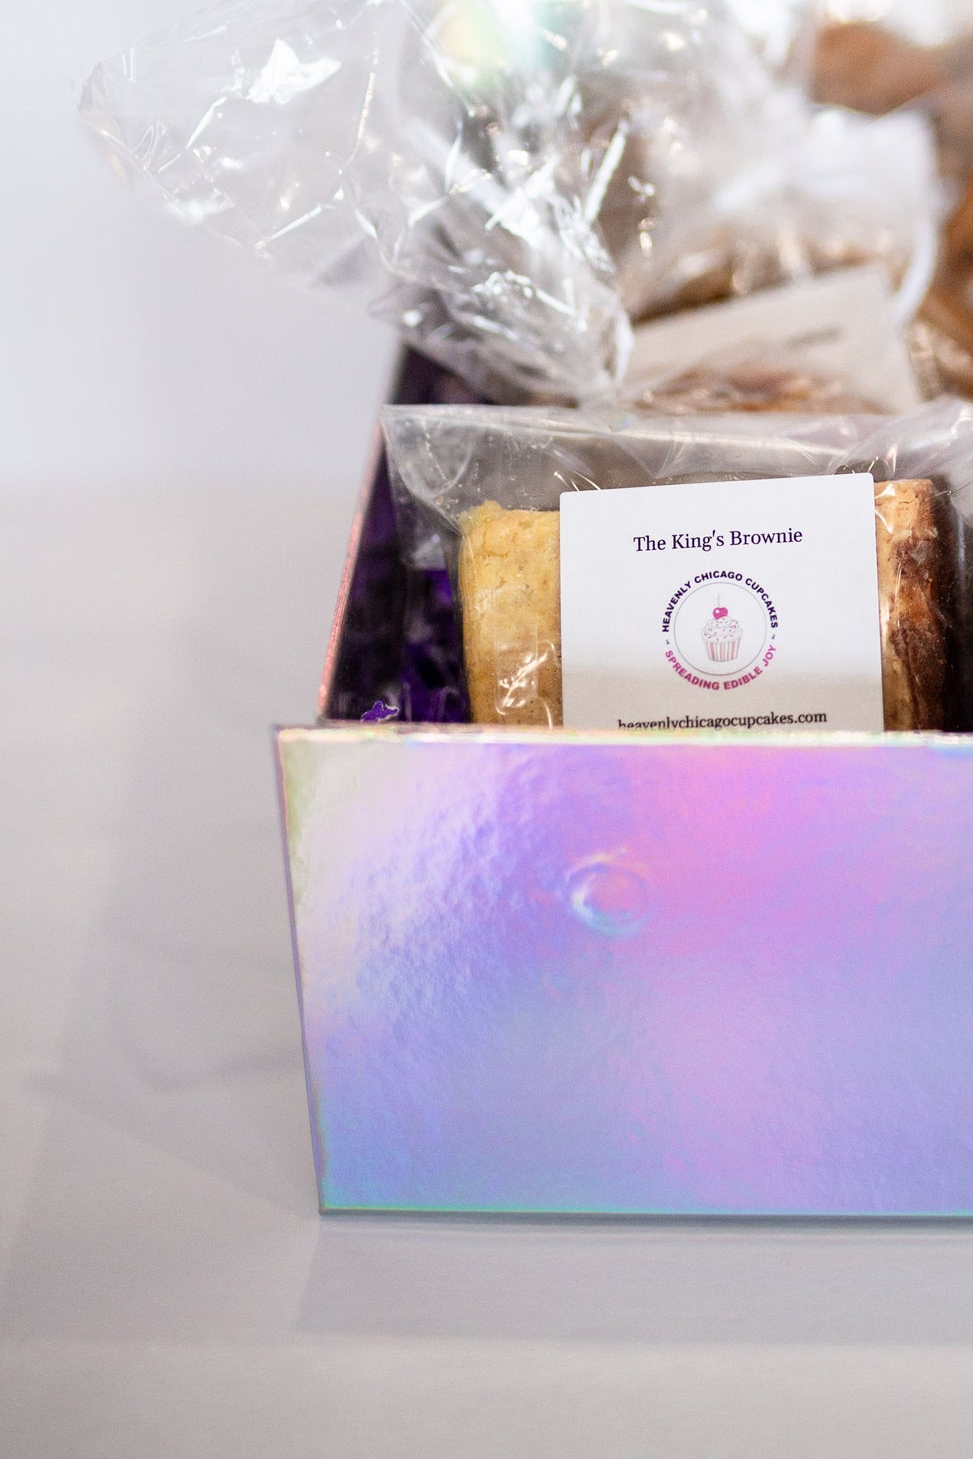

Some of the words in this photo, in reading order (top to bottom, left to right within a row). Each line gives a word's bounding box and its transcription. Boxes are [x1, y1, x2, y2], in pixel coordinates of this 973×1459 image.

[632, 535, 667, 552] The
[671, 529, 725, 552] King's
[729, 527, 803, 546] Brownie
[661, 581, 692, 633] HEAVENLY
[694, 570, 743, 584] CHICAGO
[744, 577, 779, 629] CUPCAKES
[665, 650, 720, 691] SPREADING
[723, 666, 763, 690] EDIBLE
[762, 644, 777, 667] JOY
